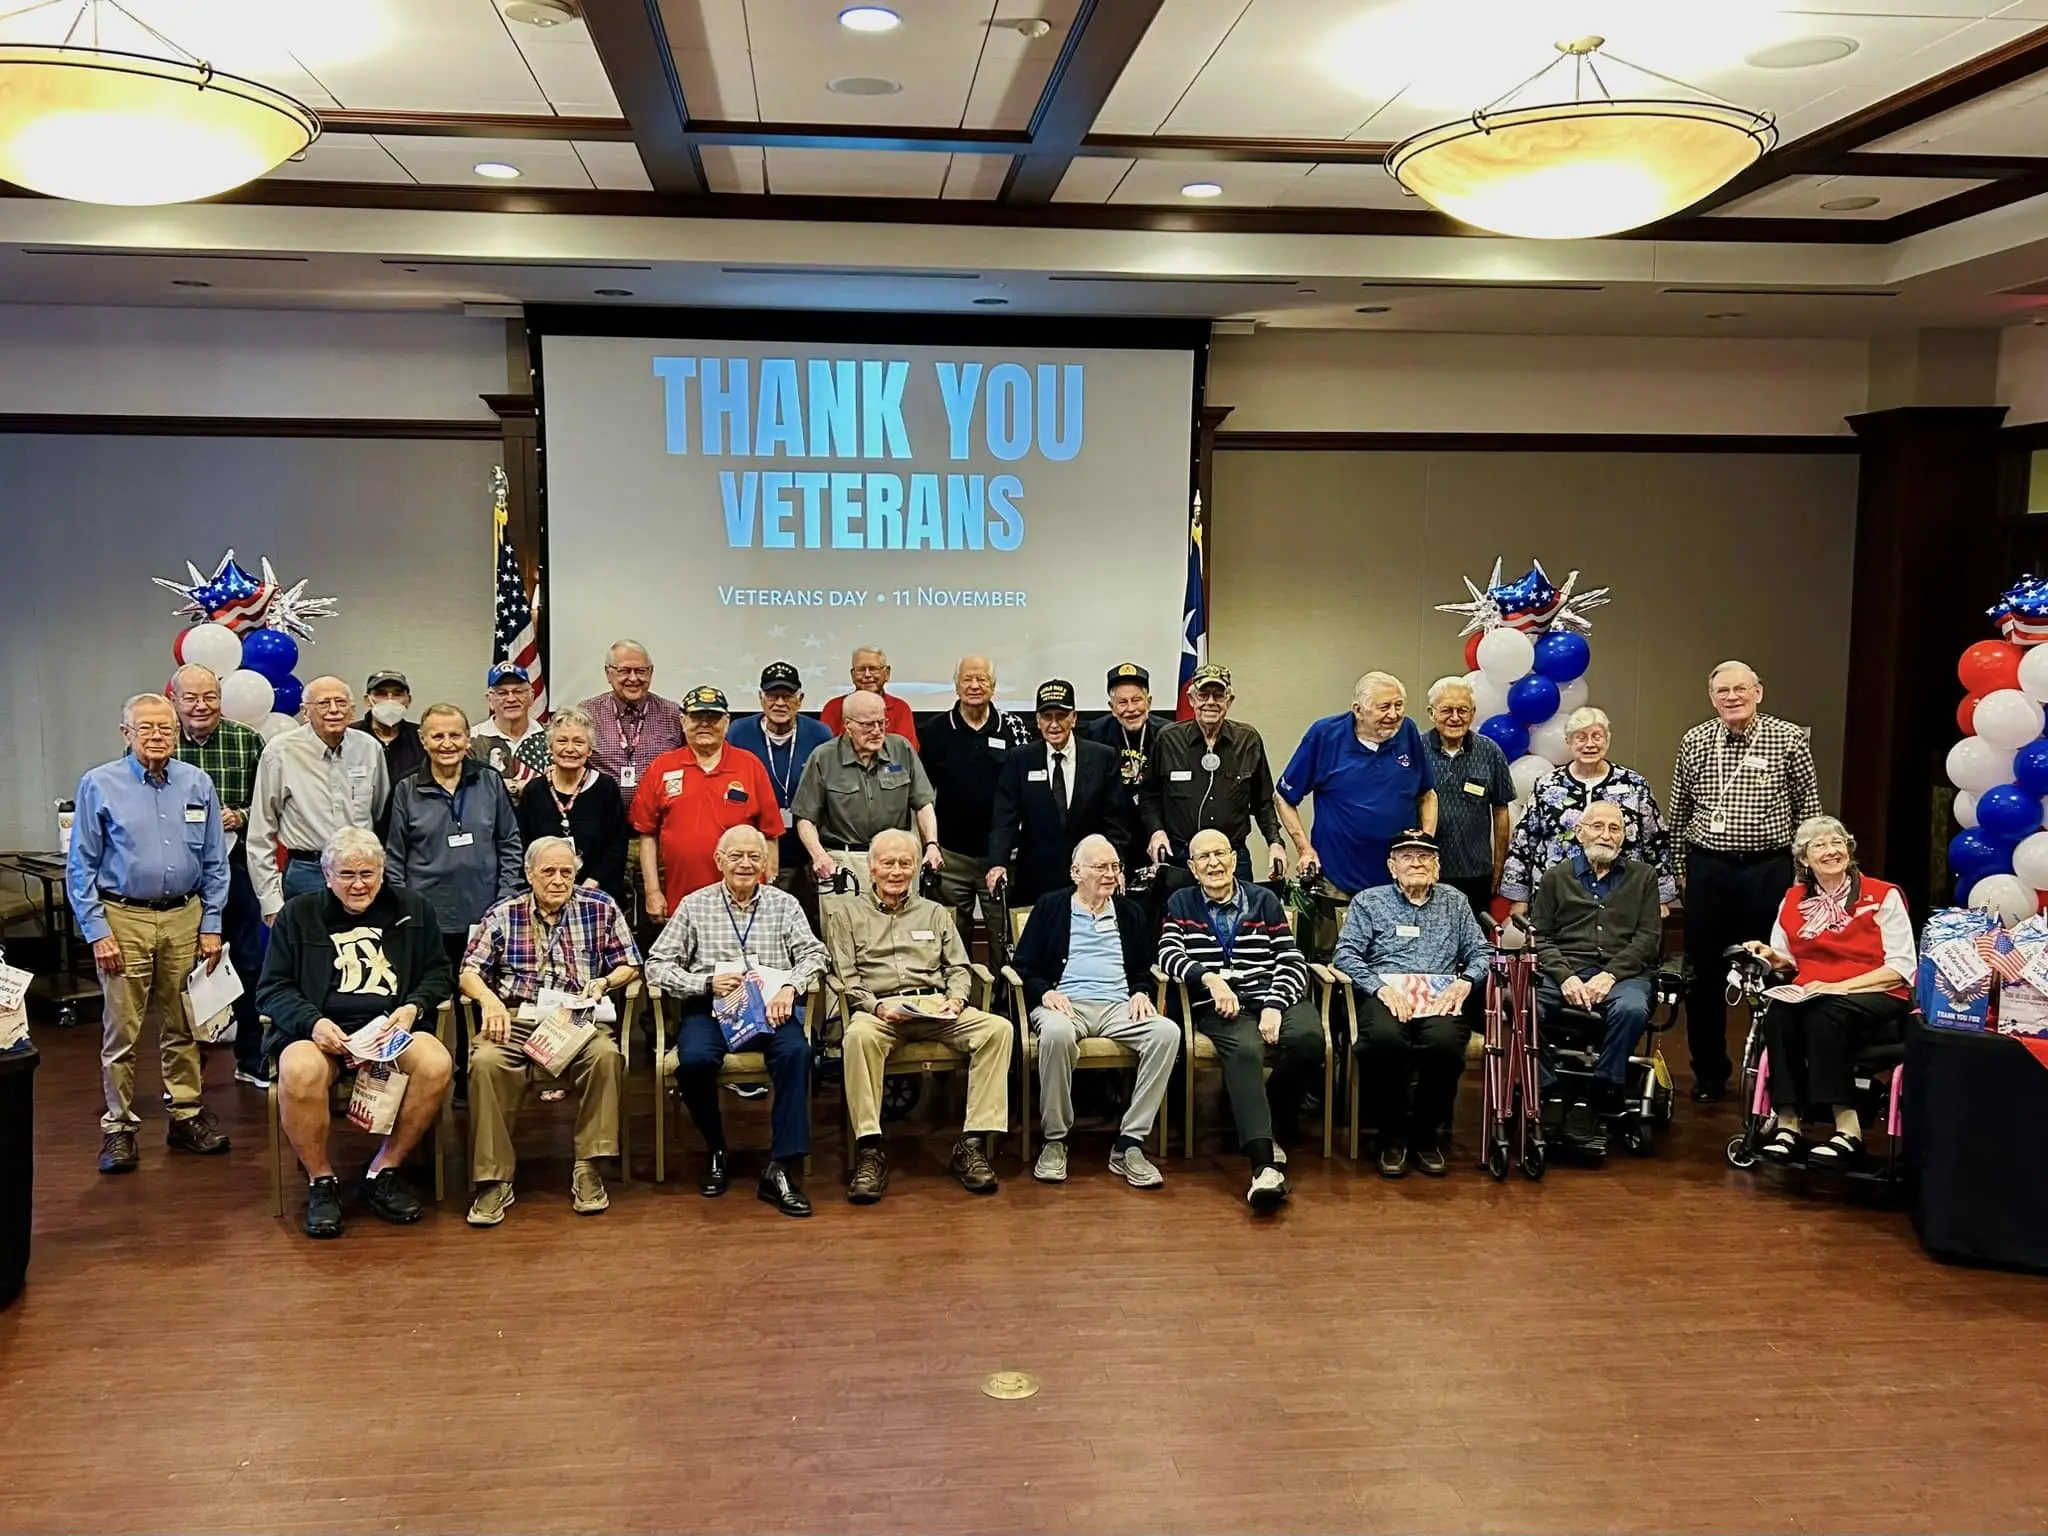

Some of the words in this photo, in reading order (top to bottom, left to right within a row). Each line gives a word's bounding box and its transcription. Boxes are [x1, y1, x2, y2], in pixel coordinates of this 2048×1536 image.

[653, 356, 912, 459] THANK
[935, 361, 1085, 461] YOU
[719, 470, 1025, 551] VETERANS
[718, 586, 823, 605] VETERANS
[893, 590, 909, 605] 11
[918, 587, 1026, 606] NOVEMBER
